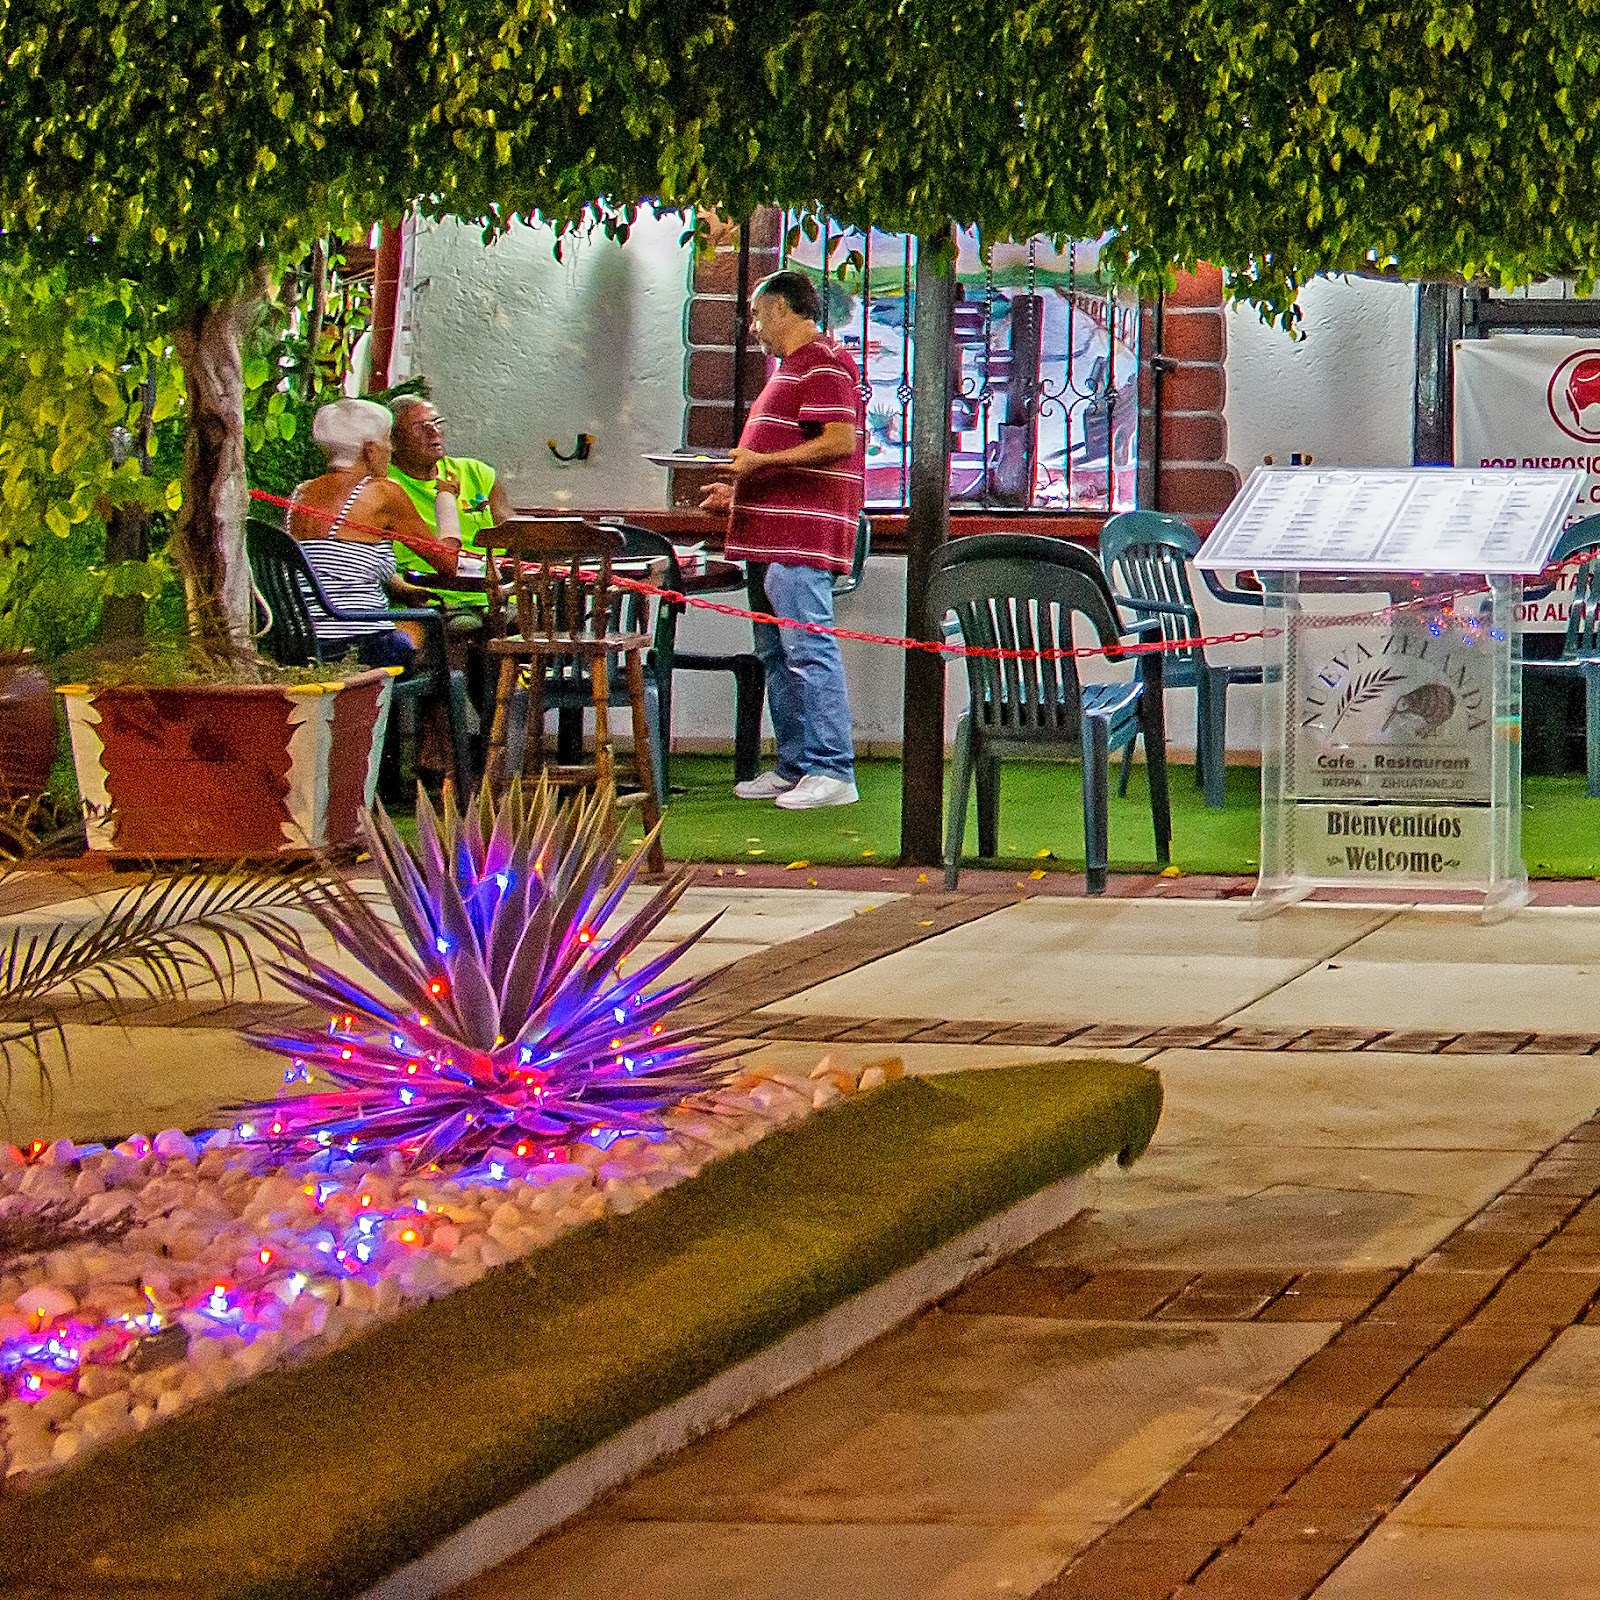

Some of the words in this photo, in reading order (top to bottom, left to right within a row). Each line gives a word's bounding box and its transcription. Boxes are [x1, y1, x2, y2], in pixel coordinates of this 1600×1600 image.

[1374, 754, 1471, 769] Restaurant
[1322, 777, 1362, 788] IXTAPA
[1380, 778, 1465, 789] ZIHUATANEJO
[1327, 811, 1462, 838] Bienvenidos
[1345, 846, 1443, 873] Welcome
